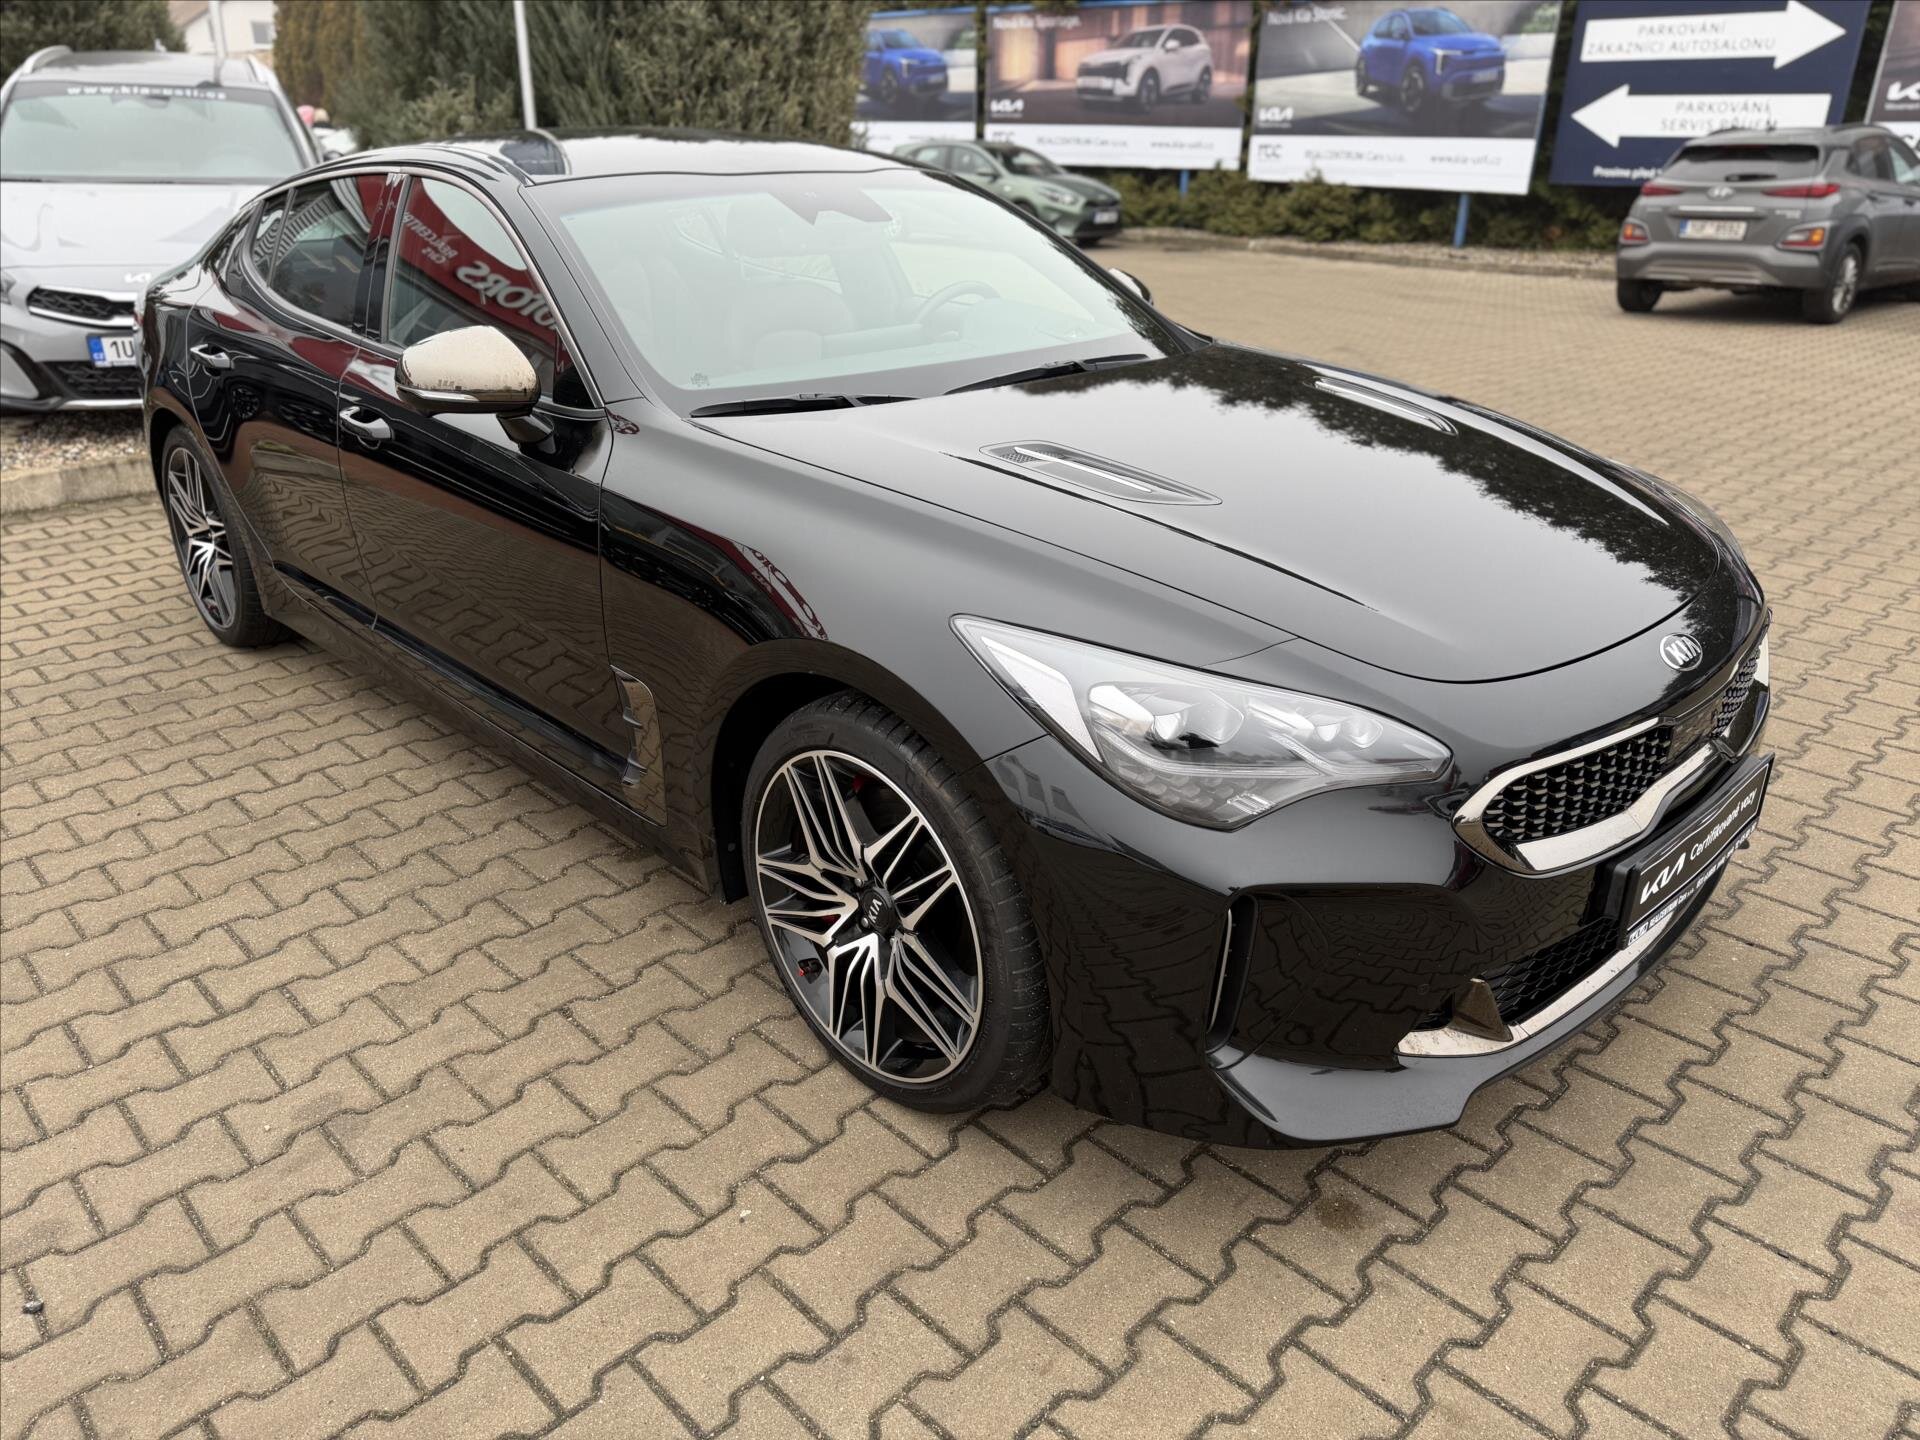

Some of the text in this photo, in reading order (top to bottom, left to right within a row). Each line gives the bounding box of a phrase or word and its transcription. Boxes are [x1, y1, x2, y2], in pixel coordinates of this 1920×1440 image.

[1637, 22, 1727, 36] PARKOVÁNÍ
[1587, 37, 1777, 55] ZÁKAZNÍCI AUTOSALONU
[1661, 118, 1714, 131] SERVIS
[1665, 636, 1702, 666] KIA
[1640, 852, 1686, 905] KIA
[867, 898, 883, 923] KIA
